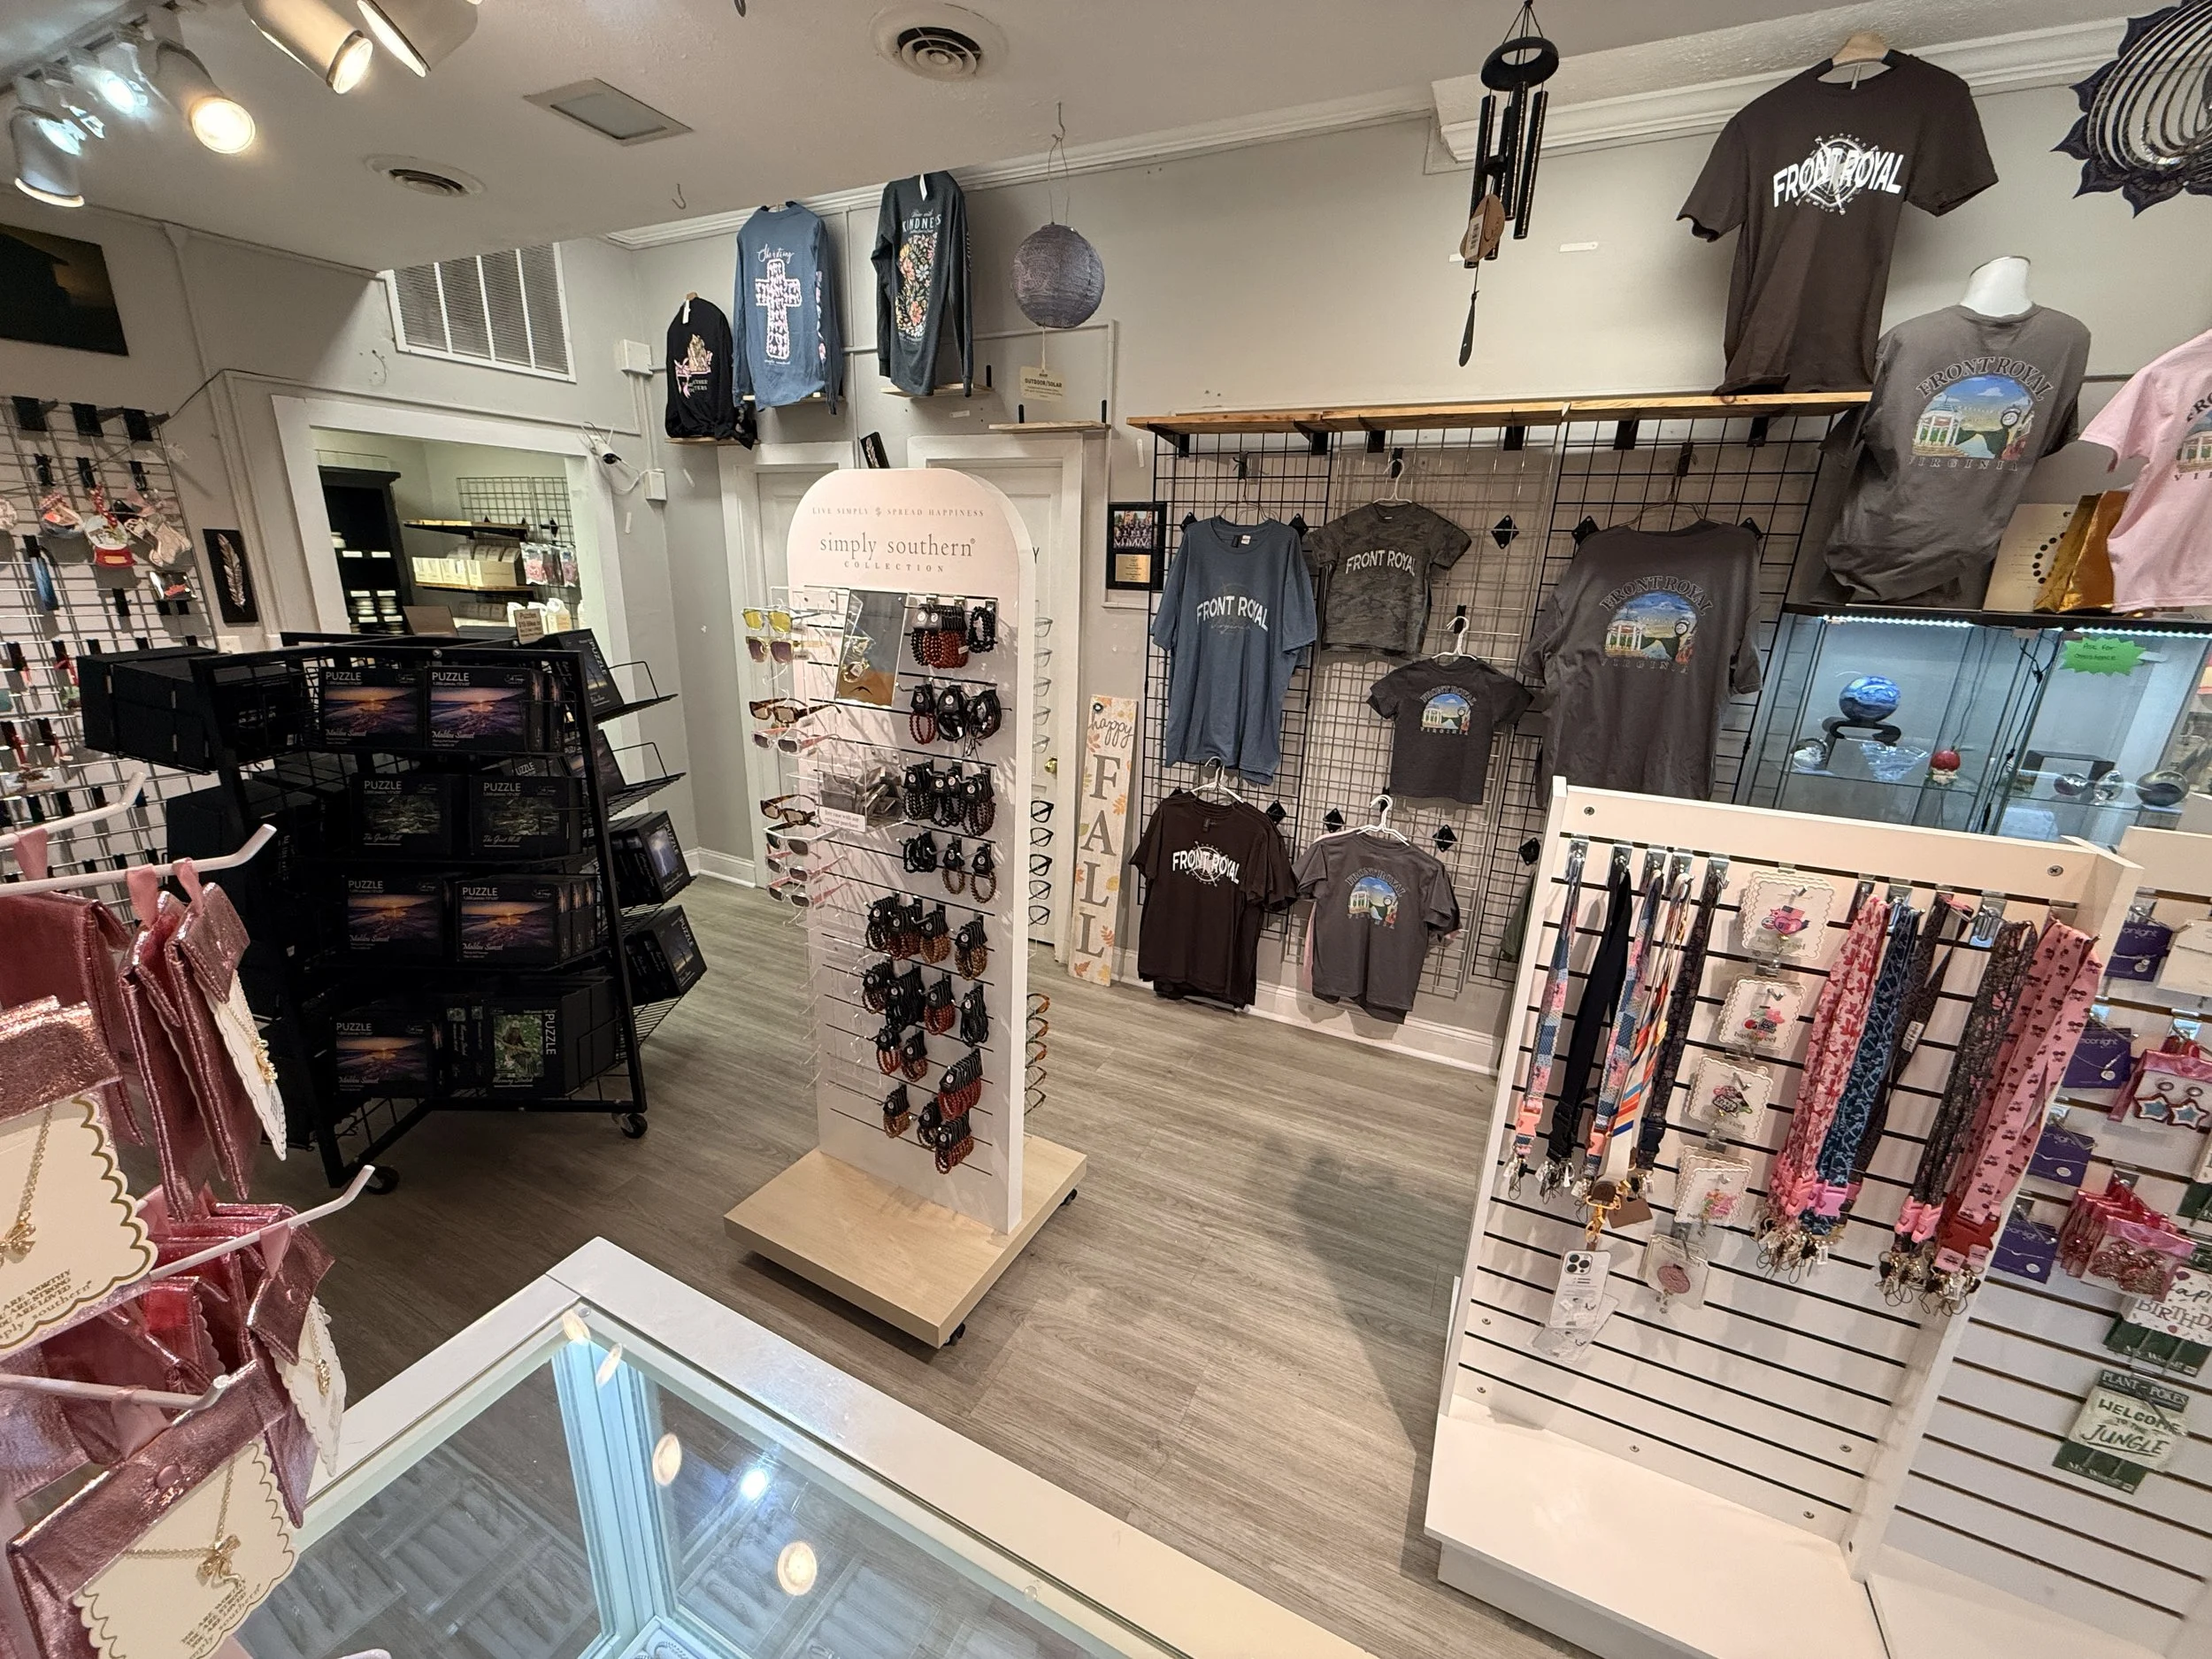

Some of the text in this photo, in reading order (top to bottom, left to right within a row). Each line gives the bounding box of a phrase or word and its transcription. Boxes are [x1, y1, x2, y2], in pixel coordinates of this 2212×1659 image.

[1773, 148, 1904, 207] FRONT ROYAL
[1916, 357, 2054, 401] FRONT ROYAL
[1909, 457, 2018, 472] VIRGINIA
[929, 508, 985, 517] HAPPINESS
[819, 532, 877, 560] simply
[844, 561, 945, 572] COLLECTION
[1345, 549, 1416, 577] FRONT ROYAL
[1600, 575, 1714, 617] FRONT ROYAL
[1196, 595, 1269, 632] FRONT ROYAL
[326, 672, 362, 682] PUZZLE
[432, 672, 470, 682] PUZZLE
[1087, 711, 1133, 749] happy
[364, 780, 403, 790] PUZZLE
[483, 782, 521, 793] PUZZLE
[1074, 754, 1121, 959] FALL
[1172, 850, 1240, 884] FRONT ROYAL
[348, 880, 384, 890] PUZZLE
[462, 887, 498, 896] PUZZLE
[336, 1022, 373, 1032] PUZZLE
[544, 1013, 557, 1056] PUZZLE
[4, 1268, 71, 1310] ARE WORTHY
[11, 1277, 72, 1315] ARE STRONG
[15, 1304, 38, 1320] ARE
[37, 1285, 72, 1306] LOVED
[2136, 1299, 2212, 1331] BIRTHD
[2101, 1371, 2139, 1390] PLANT
[2148, 1386, 2190, 1405] POKES
[2098, 1398, 2182, 1433] WELCOME
[2081, 1424, 2170, 1455] JUNGLE
